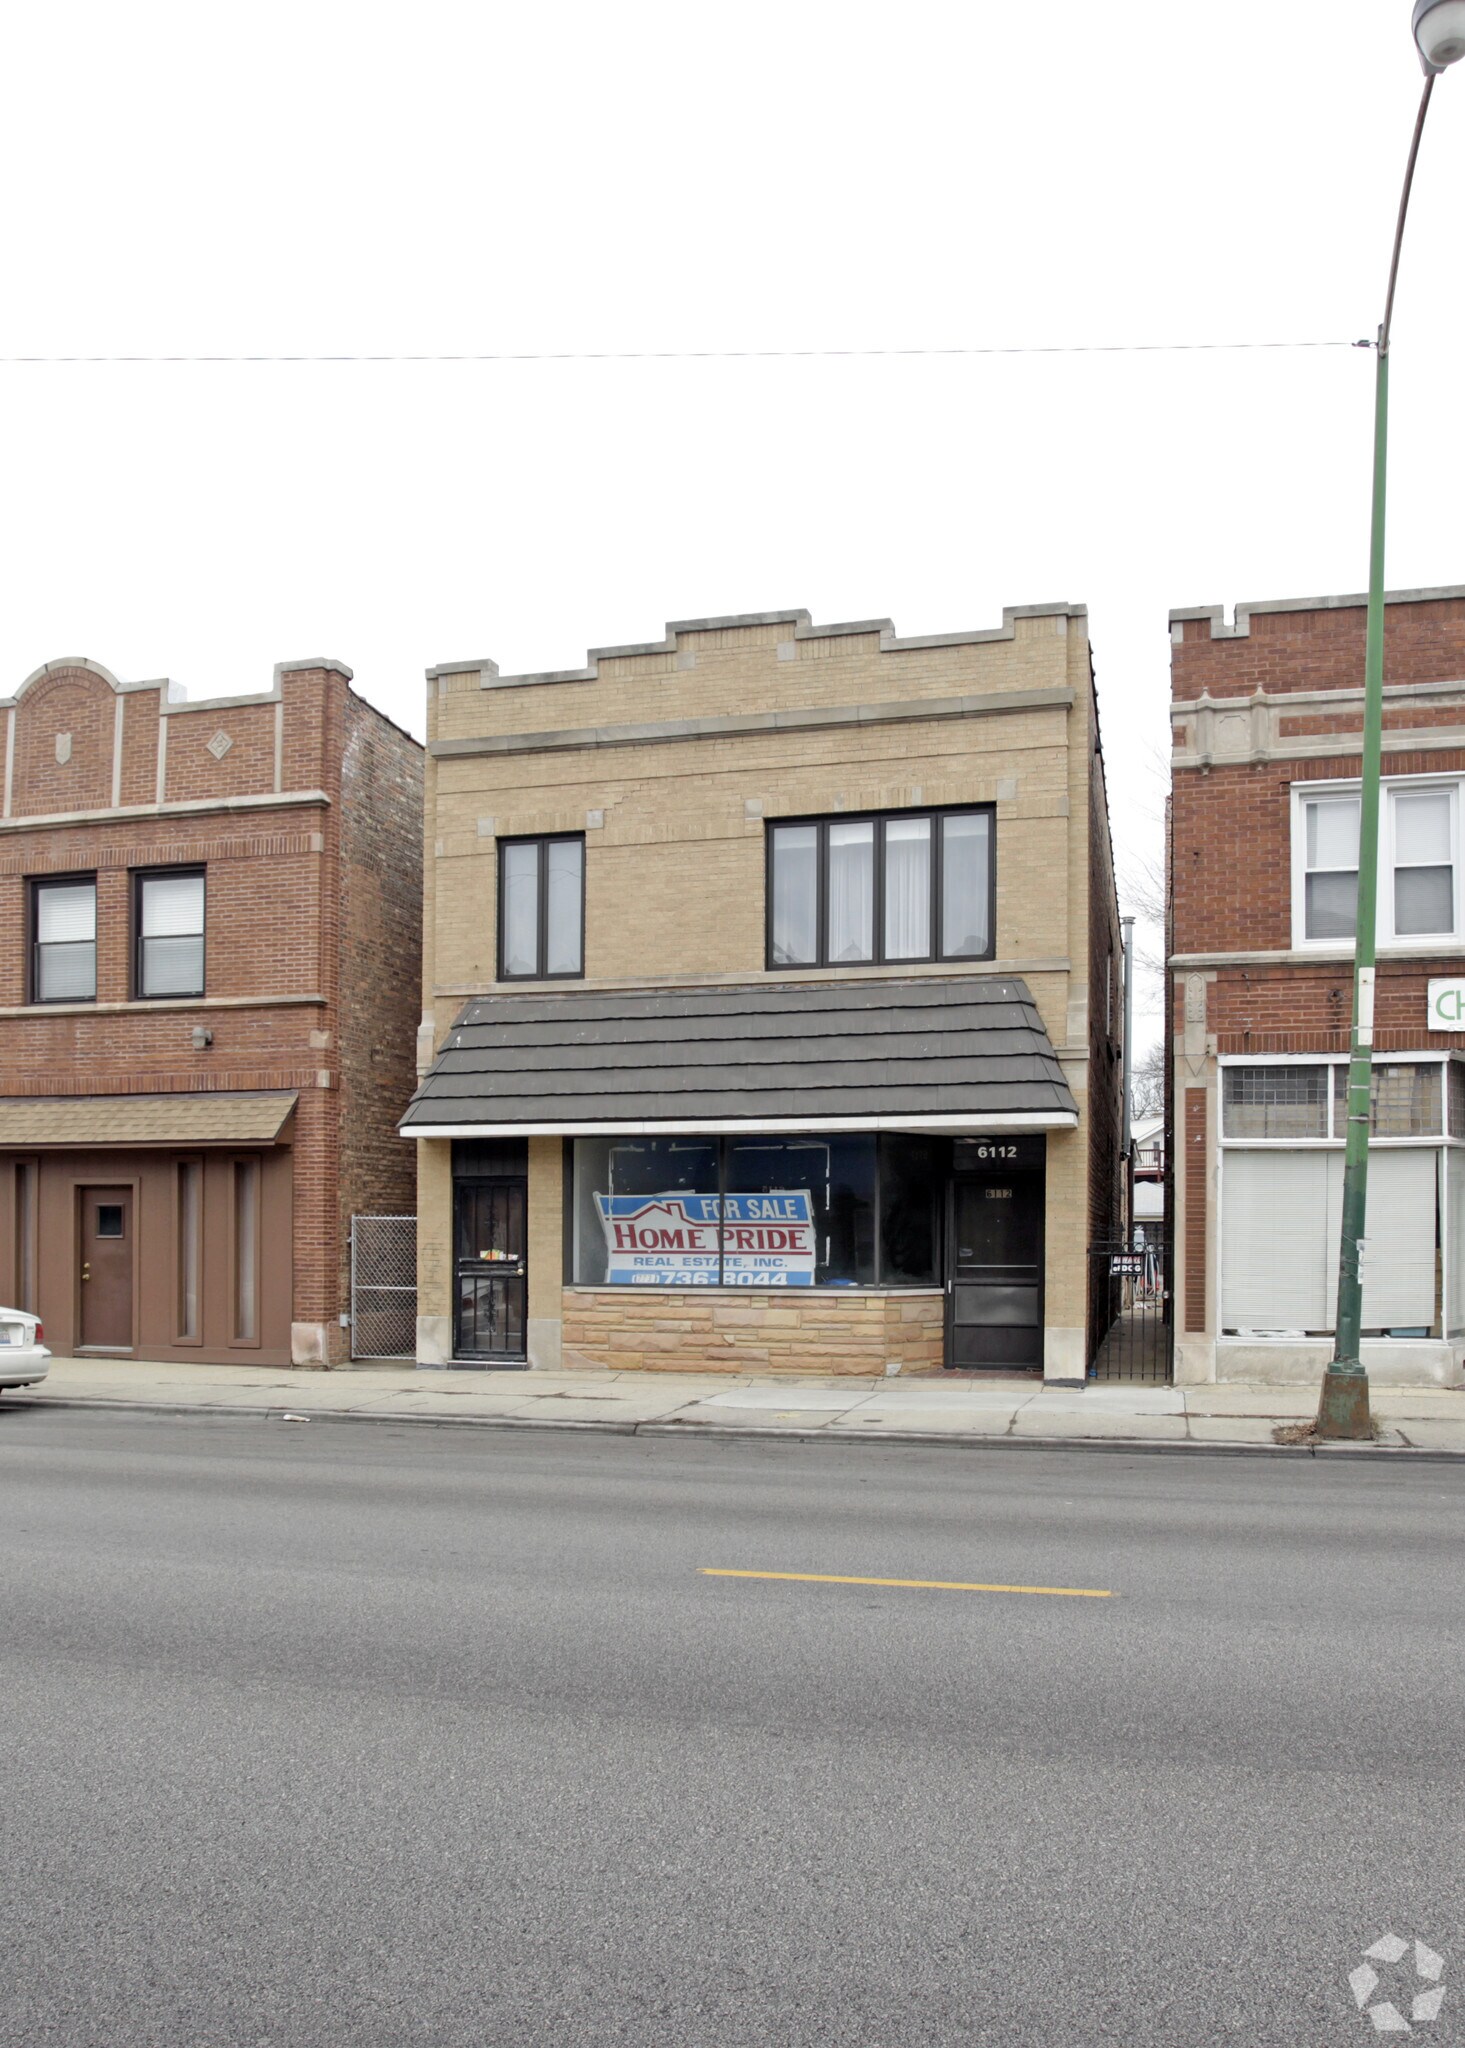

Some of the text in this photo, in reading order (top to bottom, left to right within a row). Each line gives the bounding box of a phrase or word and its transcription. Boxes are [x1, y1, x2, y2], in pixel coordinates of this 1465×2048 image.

[977, 1146, 1017, 1158] 6112
[700, 1199, 798, 1219] FOR SALE
[613, 1224, 807, 1249] HOME PRIDE
[633, 1257, 788, 1269] REAL ESTATE, INC.
